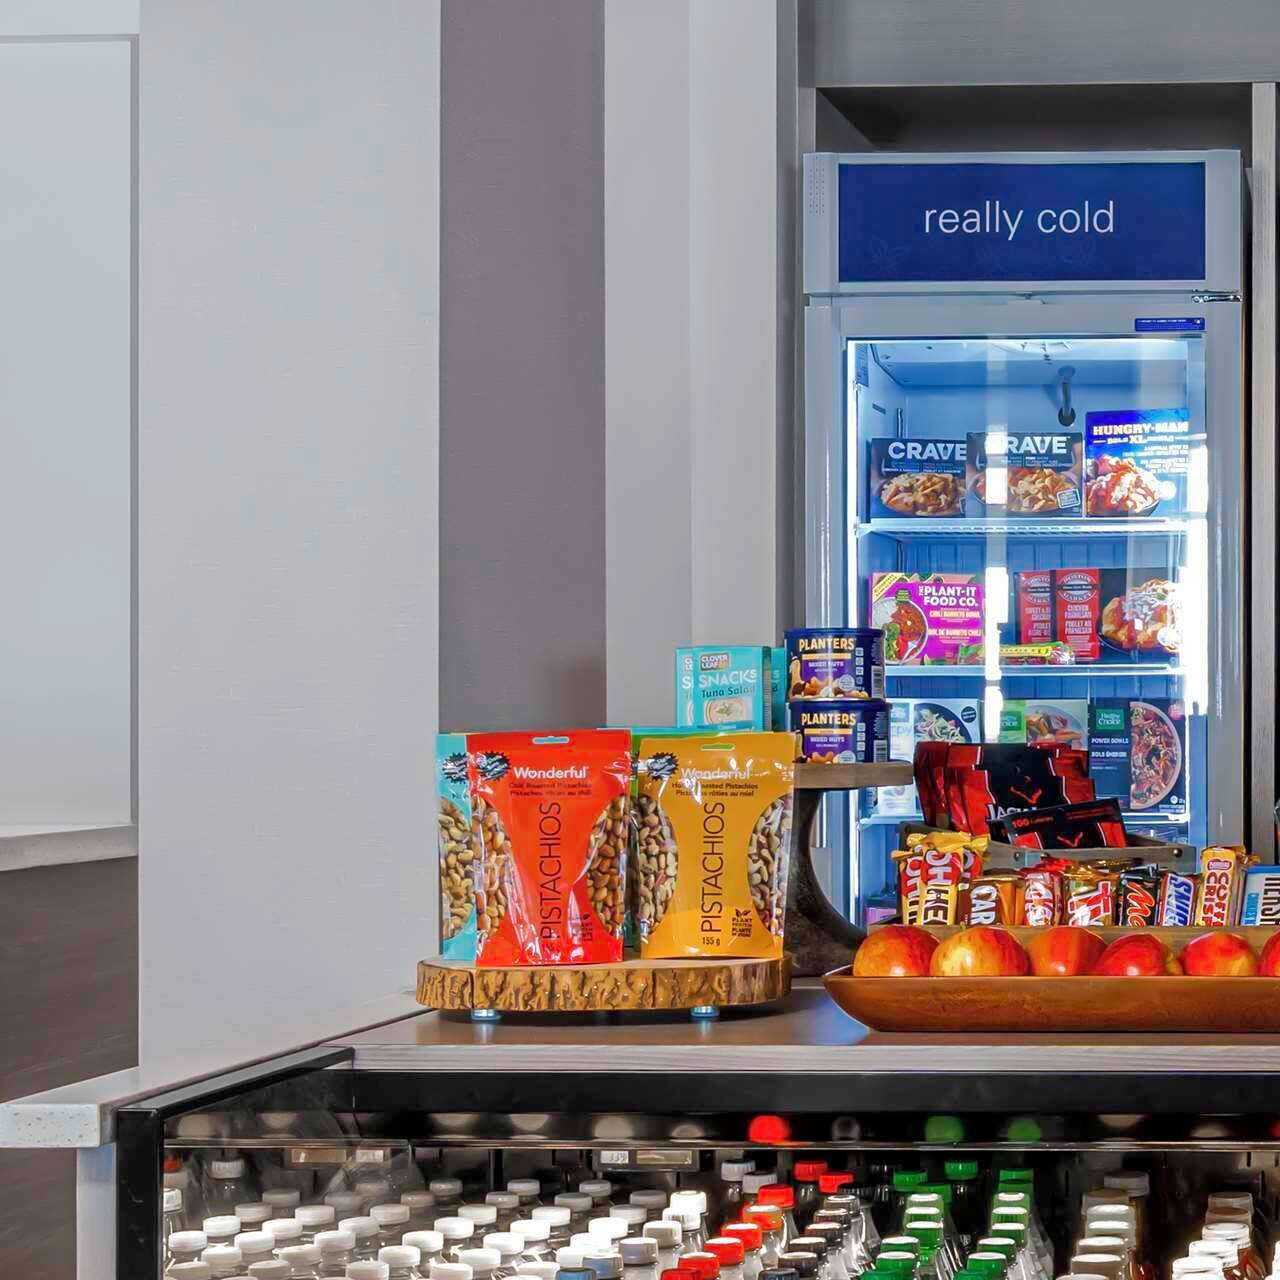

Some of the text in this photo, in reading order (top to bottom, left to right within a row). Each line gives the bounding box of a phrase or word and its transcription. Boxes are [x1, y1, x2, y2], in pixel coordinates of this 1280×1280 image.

[925, 201, 1115, 240] really cold
[888, 441, 966, 461] CRAVE
[925, 586, 977, 597] PLANT-IT
[924, 596, 958, 606] FOOD
[799, 637, 854, 651] PLANTERS
[701, 654, 728, 663] CLOVER
[699, 669, 757, 688] SNACKS
[701, 685, 755, 698] Tuna Salad
[801, 713, 856, 726] PLANTERS
[514, 766, 587, 779] Wonderful
[682, 767, 751, 779] Wonderful
[539, 801, 562, 940] PISTACHIOS
[701, 801, 725, 933] PISTACHIOS
